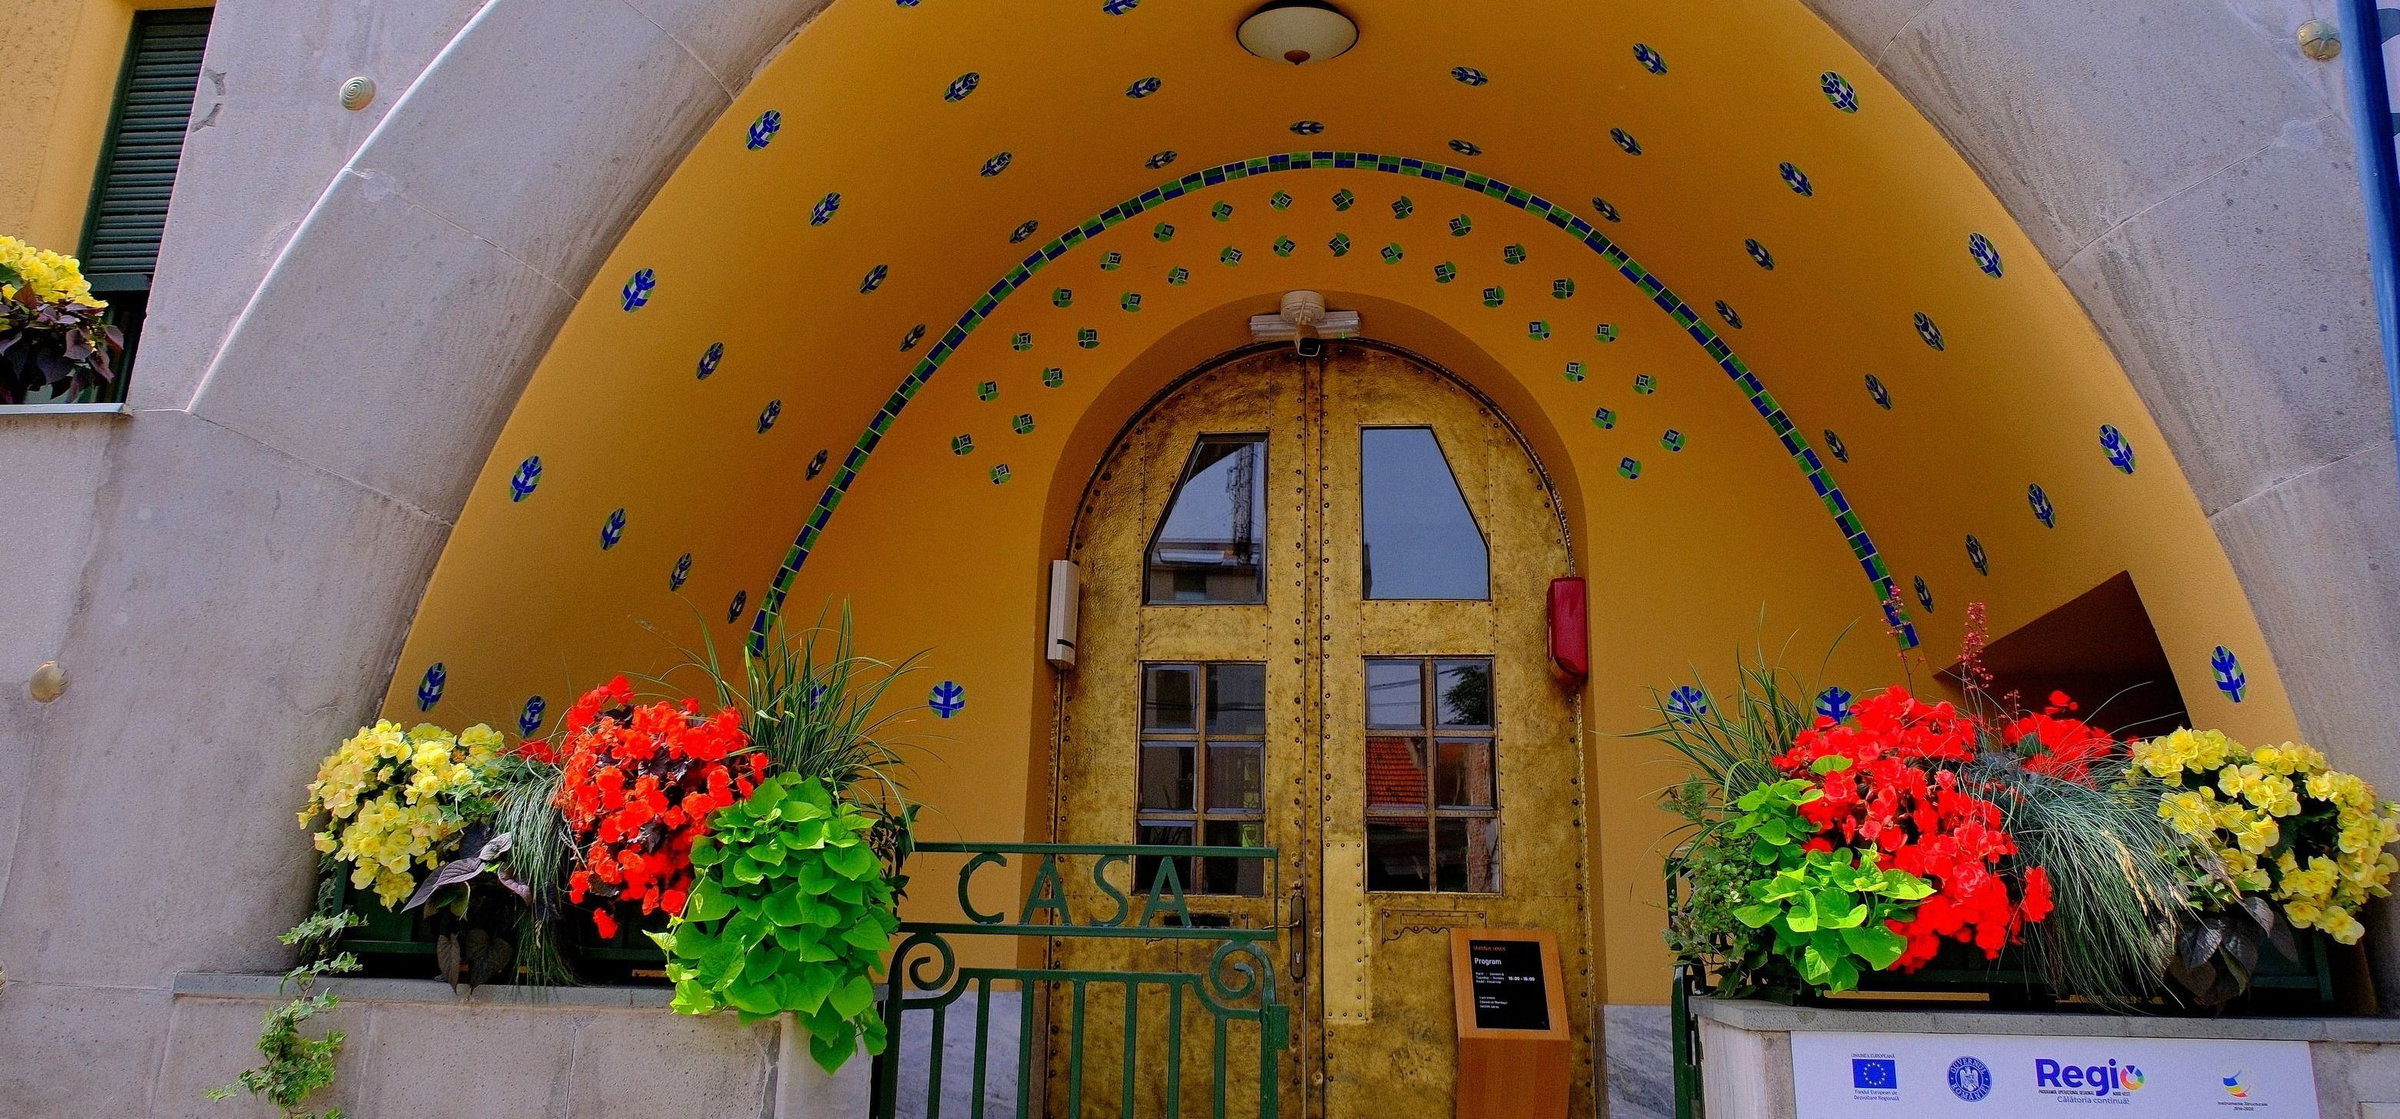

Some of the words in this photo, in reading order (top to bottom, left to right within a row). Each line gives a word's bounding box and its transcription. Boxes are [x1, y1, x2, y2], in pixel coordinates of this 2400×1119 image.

[958, 852, 1192, 928] CASA
[1474, 957, 1502, 966] Program
[2035, 1058, 2145, 1097] Regio
